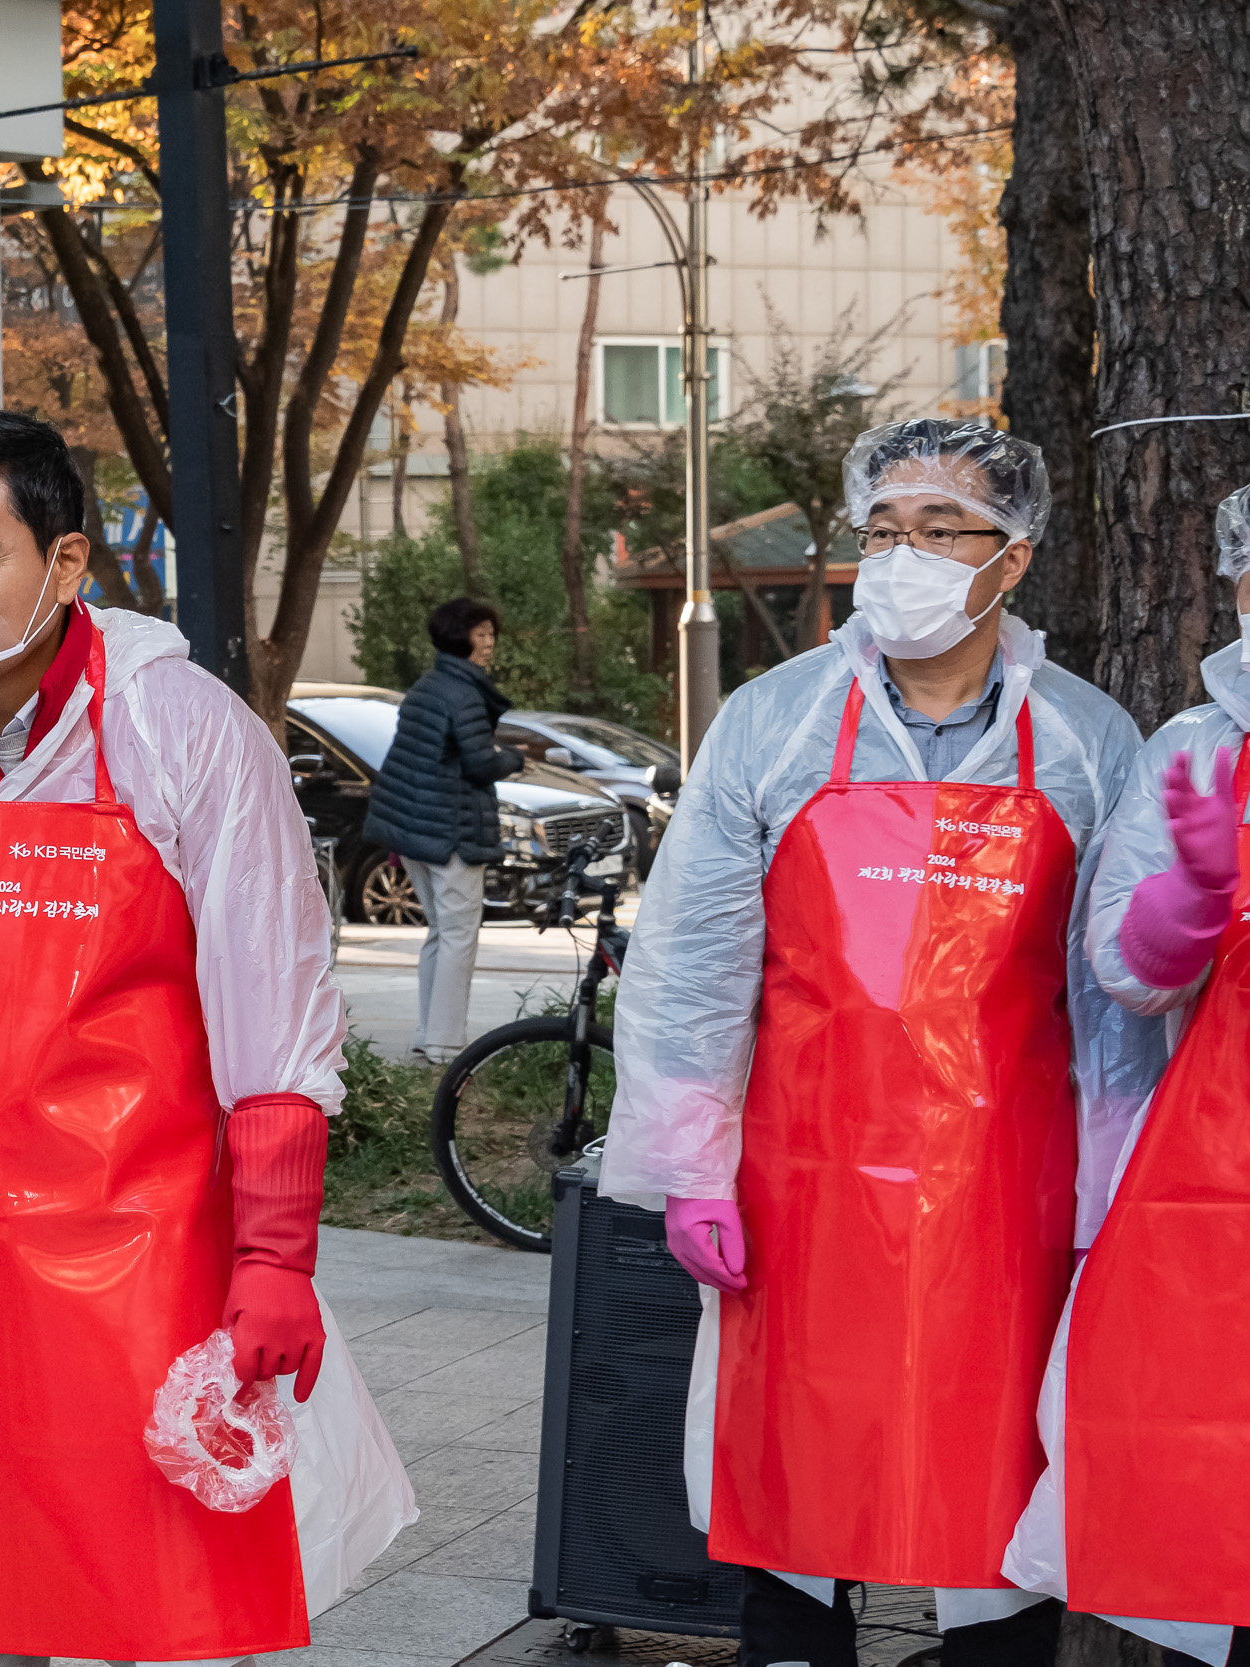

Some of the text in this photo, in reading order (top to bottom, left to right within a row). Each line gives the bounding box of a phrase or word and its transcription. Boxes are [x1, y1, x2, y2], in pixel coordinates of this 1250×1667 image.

[958, 821, 1022, 838] KB국민은행
[34, 845, 106, 862] KB국민은행
[927, 854, 956, 867] 2024
[857, 866, 1025, 896] 제2회 광진 사랑의 김장축제
[42, 900, 99, 920] 김장축제
